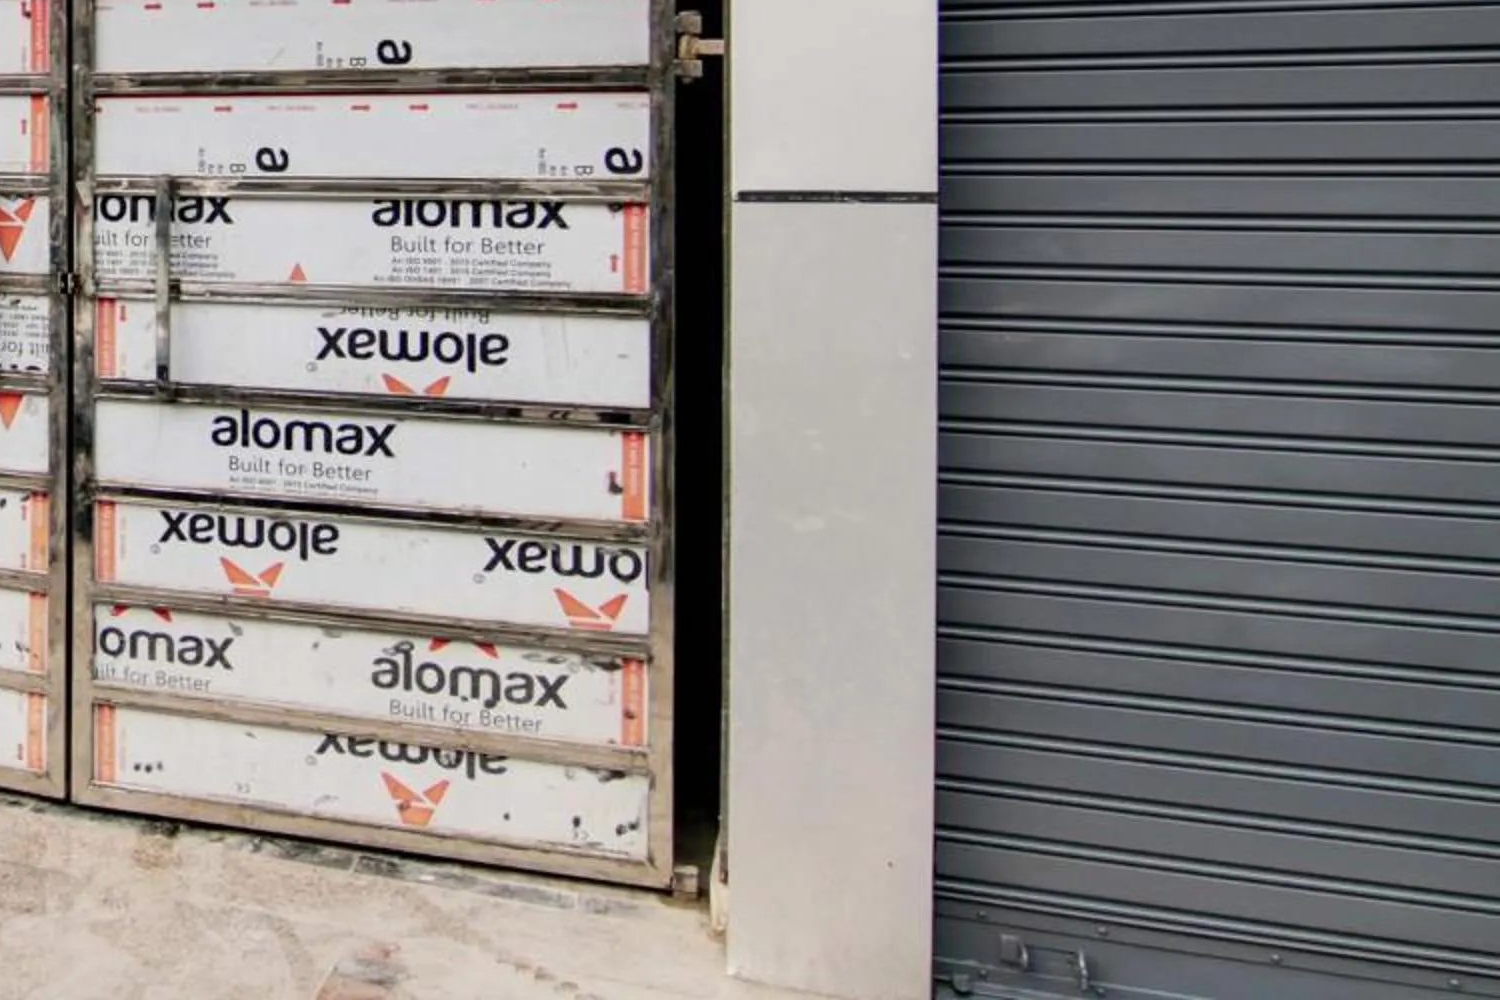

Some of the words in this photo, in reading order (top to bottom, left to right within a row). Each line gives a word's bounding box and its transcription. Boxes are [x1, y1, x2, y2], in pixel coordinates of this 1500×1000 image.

[391, 235, 437, 254] Built
[444, 235, 474, 254] for
[481, 236, 546, 256] Better
[316, 327, 509, 373] alomax
[212, 409, 397, 458] alomax
[228, 455, 271, 473] Built
[278, 458, 304, 476] for
[312, 461, 373, 481] Better
[159, 510, 340, 561] alomax
[123, 666, 150, 686] for
[155, 670, 212, 693] Better
[372, 642, 569, 709] alomax
[389, 700, 436, 722] Built
[443, 703, 472, 726] for
[479, 708, 544, 734] Better
